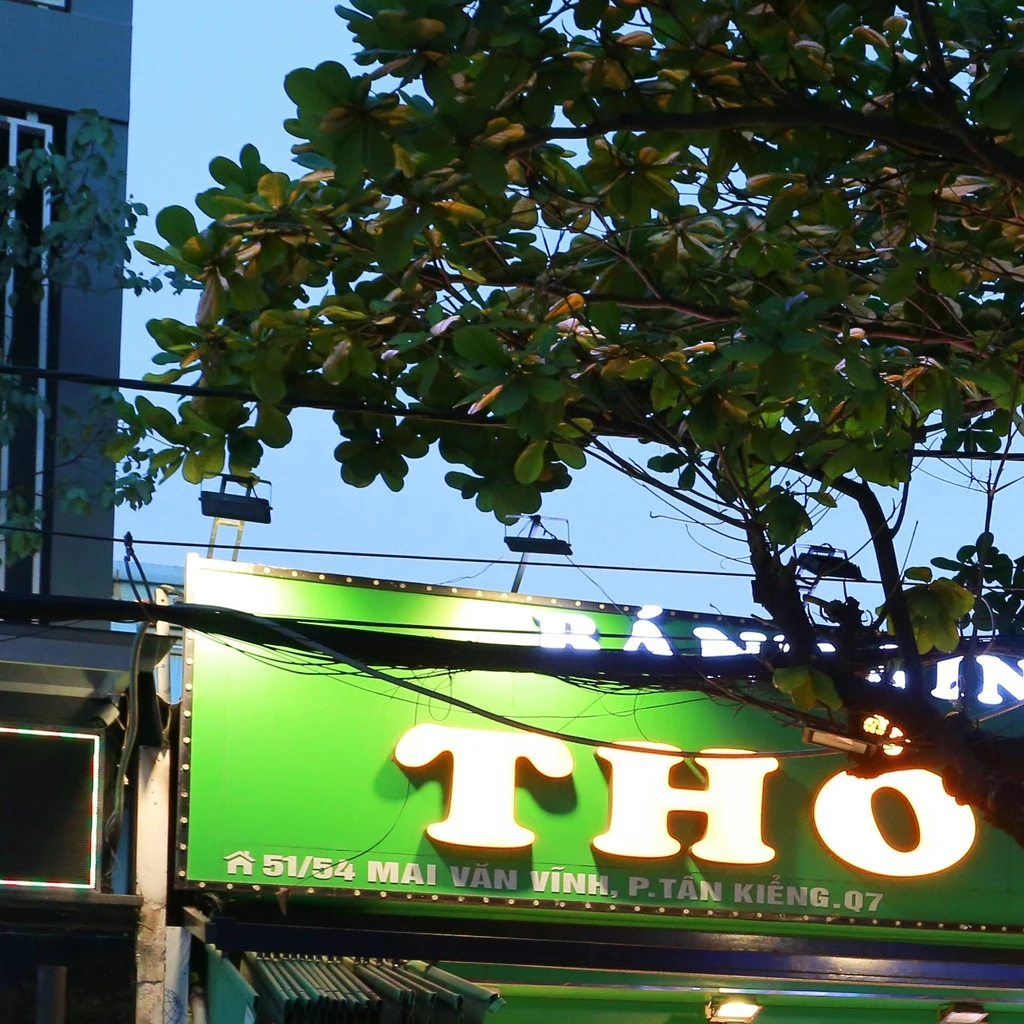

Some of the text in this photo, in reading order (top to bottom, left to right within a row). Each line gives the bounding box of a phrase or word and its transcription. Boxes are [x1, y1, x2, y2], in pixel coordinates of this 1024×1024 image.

[263, 854, 356, 881] 51/54
[367, 860, 437, 886] MAI
[450, 863, 518, 890] VĂN
[530, 866, 618, 899] VĨNH,
[628, 874, 723, 902] P.TÂN
